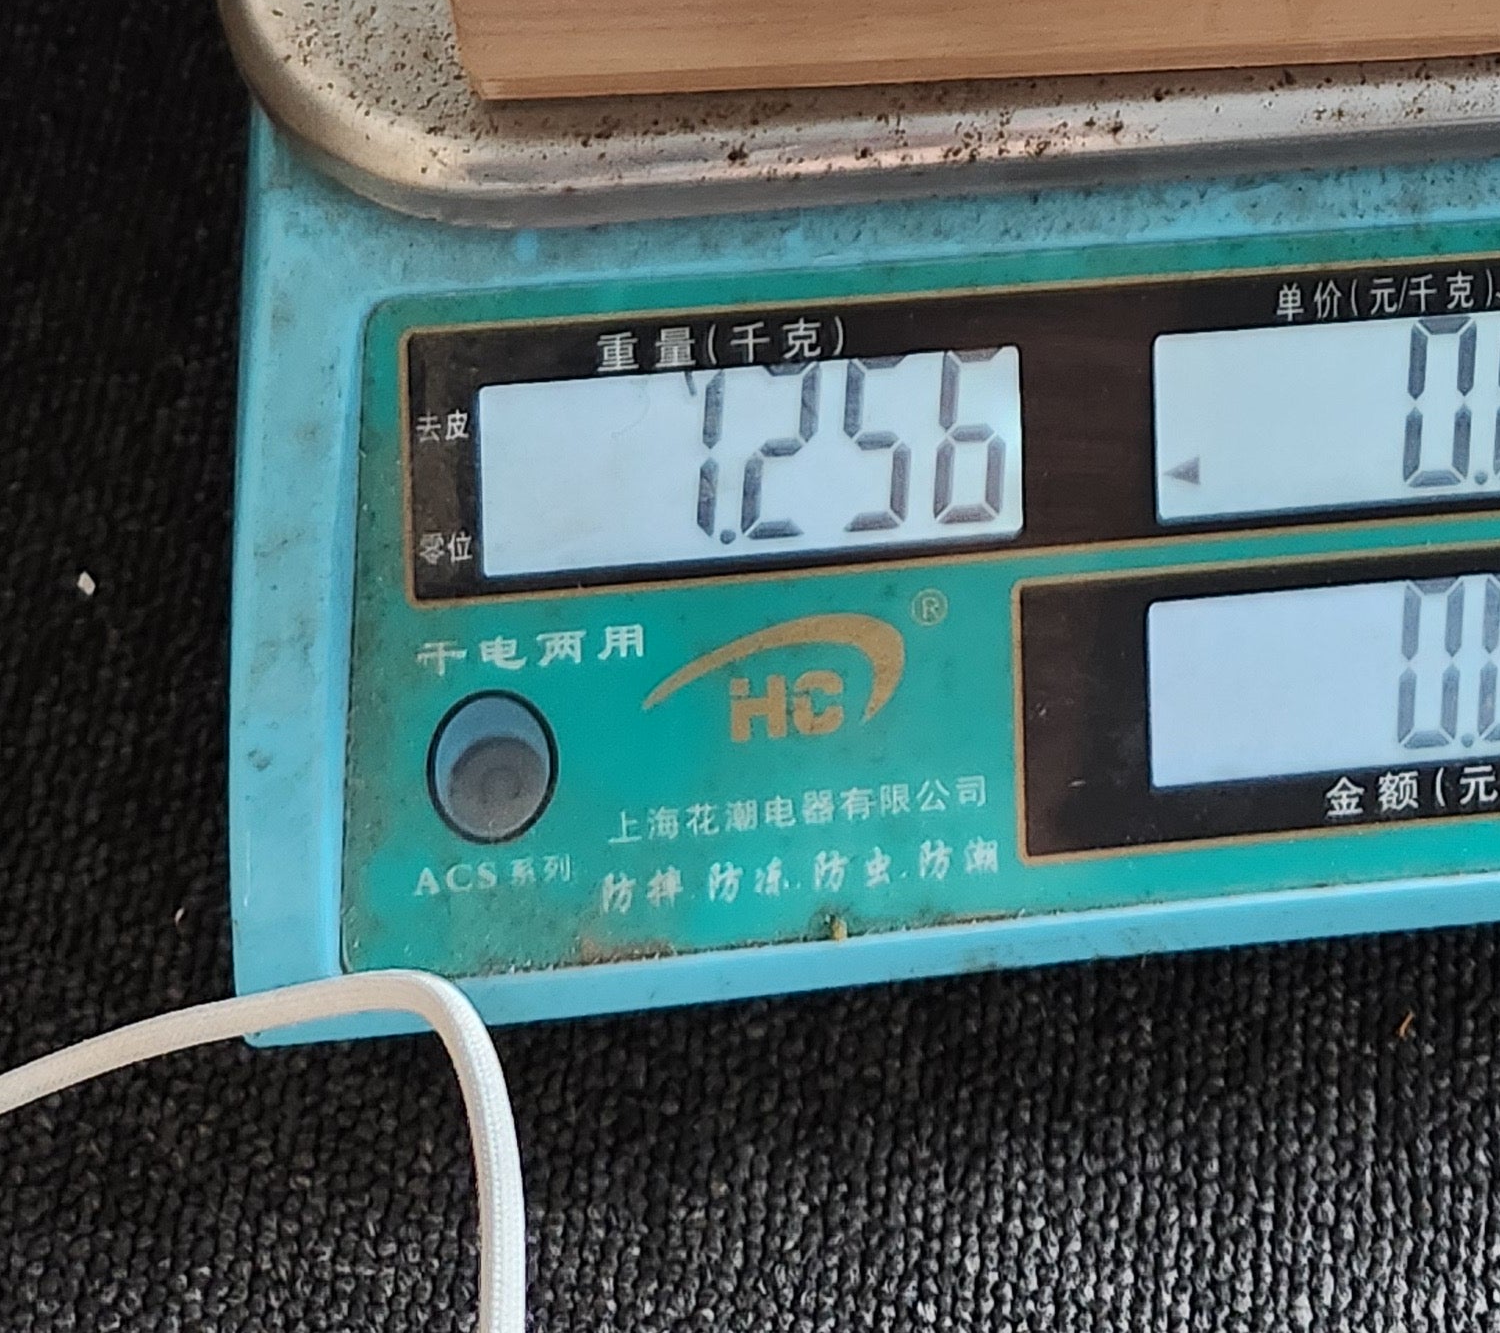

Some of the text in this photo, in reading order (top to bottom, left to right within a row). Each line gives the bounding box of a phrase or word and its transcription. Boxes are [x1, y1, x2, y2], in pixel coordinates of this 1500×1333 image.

[1276, 268, 1496, 317] 单价(元/千克)
[596, 317, 848, 372] 重量(千克)
[416, 409, 470, 443] 去皮
[416, 624, 645, 676] 干电两用
[729, 670, 845, 743] HC
[607, 774, 989, 846] 上海花潮电器有限公司
[414, 853, 573, 897] ACS 系列
